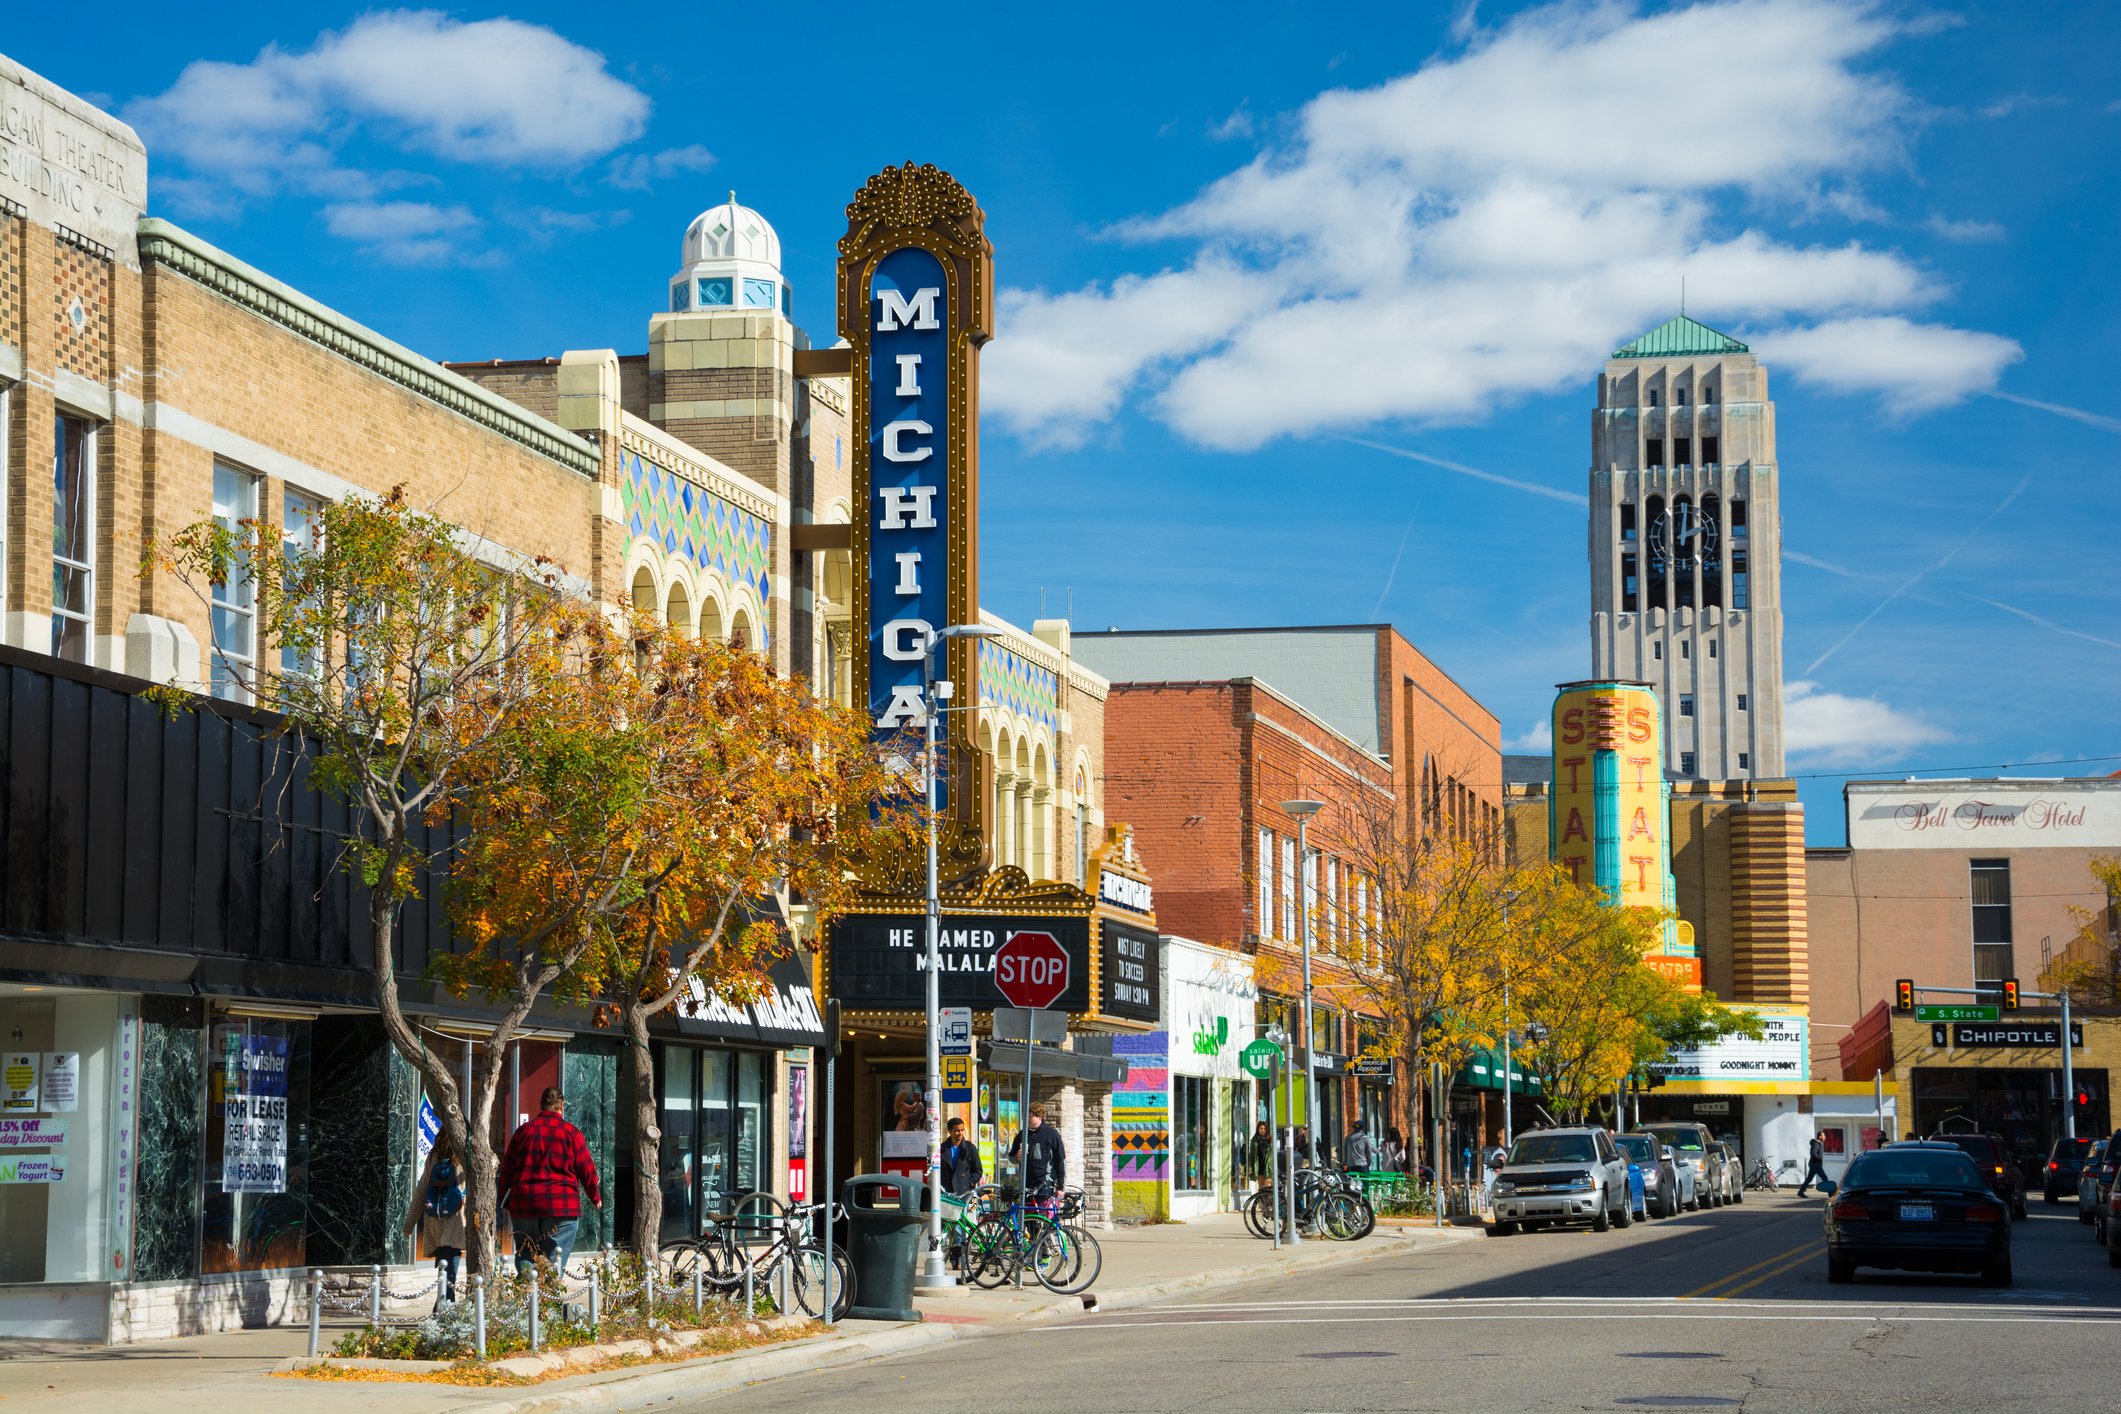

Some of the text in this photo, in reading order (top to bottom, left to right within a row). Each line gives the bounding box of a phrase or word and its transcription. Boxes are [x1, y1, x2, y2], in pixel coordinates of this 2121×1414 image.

[56, 130, 126, 194] THEATER
[0, 146, 82, 213] BUILDING
[1561, 707, 1589, 890] STAT
[1626, 706, 1656, 940] STAT
[1894, 800, 2087, 831] Bell Tower Hotel
[889, 929, 914, 947] HE
[925, 930, 995, 947] AMED
[1118, 936, 1146, 960] MOST LIKELY
[1000, 955, 1063, 985] STOP
[1118, 960, 1144, 982] TO SUCCEED
[1114, 982, 1132, 1002] SUNDAY
[1938, 1010, 1984, 1018] S. State
[1769, 1033, 1800, 1041] PEOPLE
[1960, 1030, 2056, 1042] CHIPOTLE
[118, 1014, 130, 1111] Frozen
[242, 1048, 286, 1072] Swisher
[1720, 1061, 1765, 1069] GOODNIGHT
[227, 1098, 285, 1120] FOR LEASE
[21, 1120, 40, 1132] Off
[230, 1124, 280, 1142] RETAIL SPACE
[21, 1133, 64, 1143] Discount
[18, 1172, 48, 1181] Yogurt
